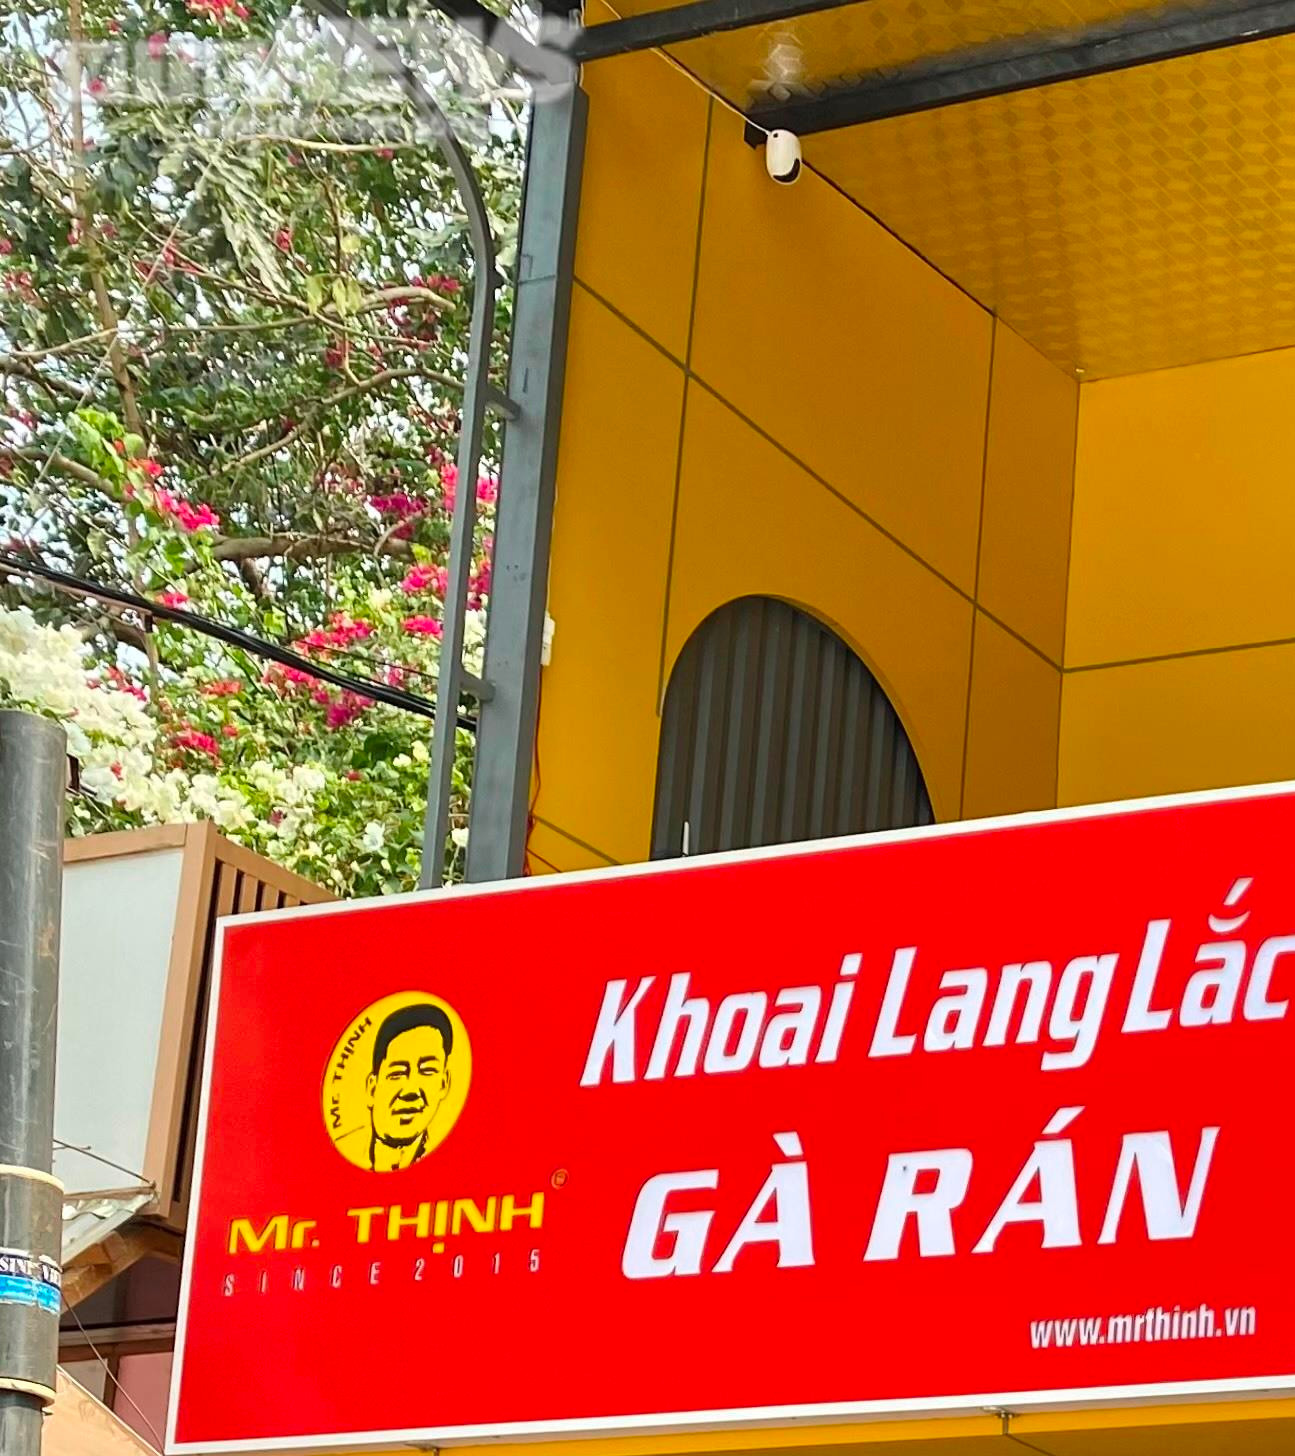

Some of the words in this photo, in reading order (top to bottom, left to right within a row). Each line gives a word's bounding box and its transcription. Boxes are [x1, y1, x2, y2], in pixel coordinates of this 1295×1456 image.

[579, 953, 862, 1087] Khoai
[868, 947, 1119, 1071] Lang
[228, 1214, 320, 1255] Mr.
[346, 1191, 546, 1255] THỊNH
[622, 1131, 815, 1279] GÀ
[863, 1106, 1219, 1261] RÁN
[1029, 1303, 1257, 1349] www.mrthinh.vn
